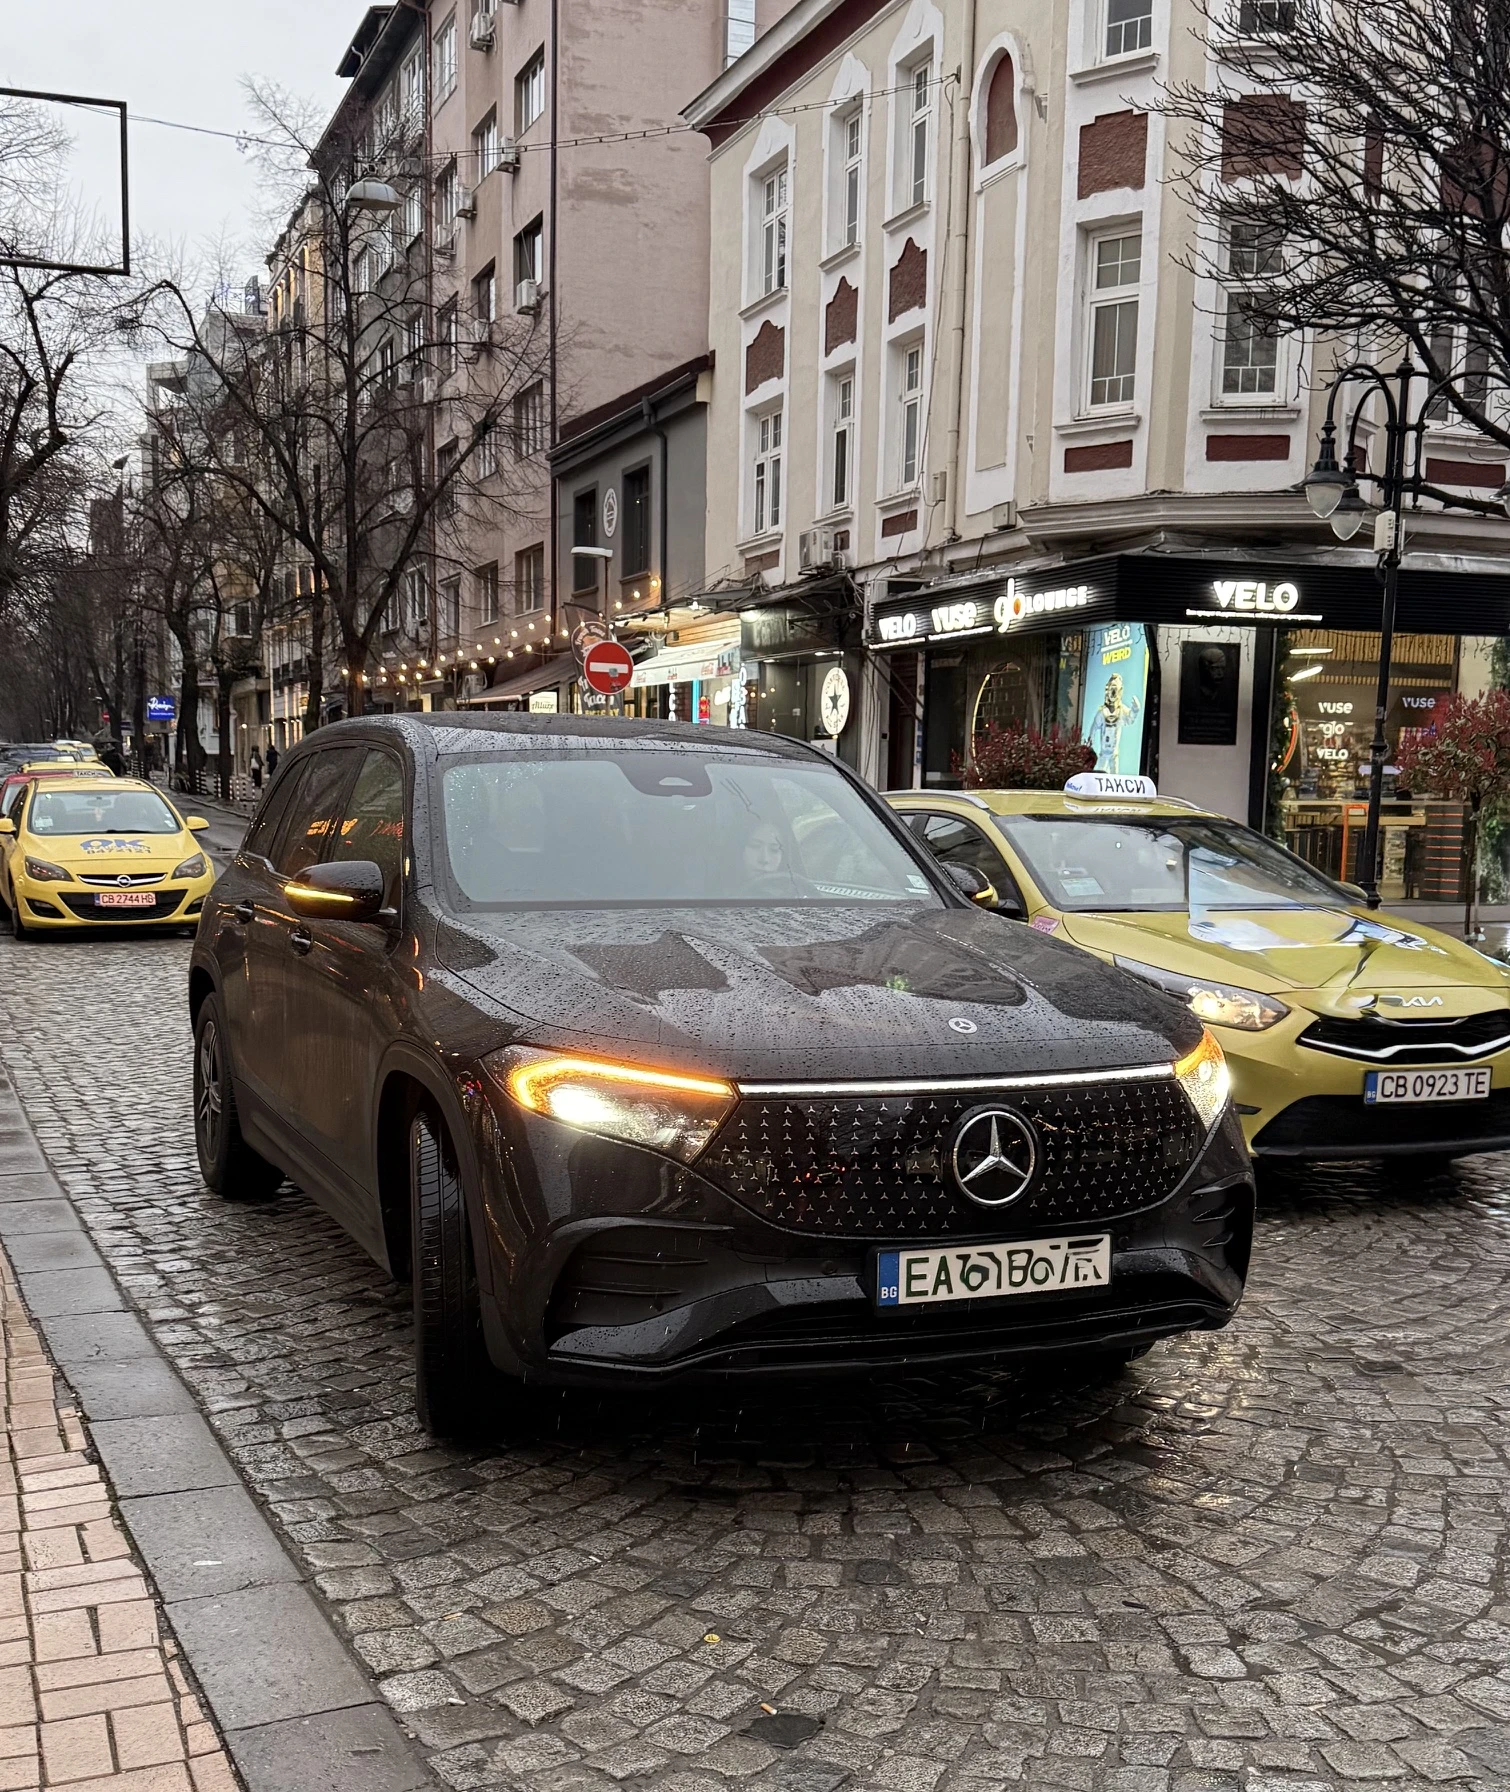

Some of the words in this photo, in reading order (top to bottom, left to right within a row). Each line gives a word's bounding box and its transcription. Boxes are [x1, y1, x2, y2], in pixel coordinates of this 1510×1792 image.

[1213, 581, 1298, 612] VELO
[878, 613, 916, 640] VELO
[1104, 625, 1131, 646] VELO
[1318, 702, 1353, 714] vuse
[1402, 697, 1436, 708] vuse
[1322, 720, 1345, 738] glo
[1317, 748, 1348, 760] VELO
[1095, 777, 1146, 794] ТАКСИ
[117, 894, 140, 904] 2744
[1381, 1075, 1408, 1099] CB
[1412, 1073, 1459, 1098] 0923
[1464, 1072, 1488, 1095] TE
[881, 1286, 898, 1299] BG
